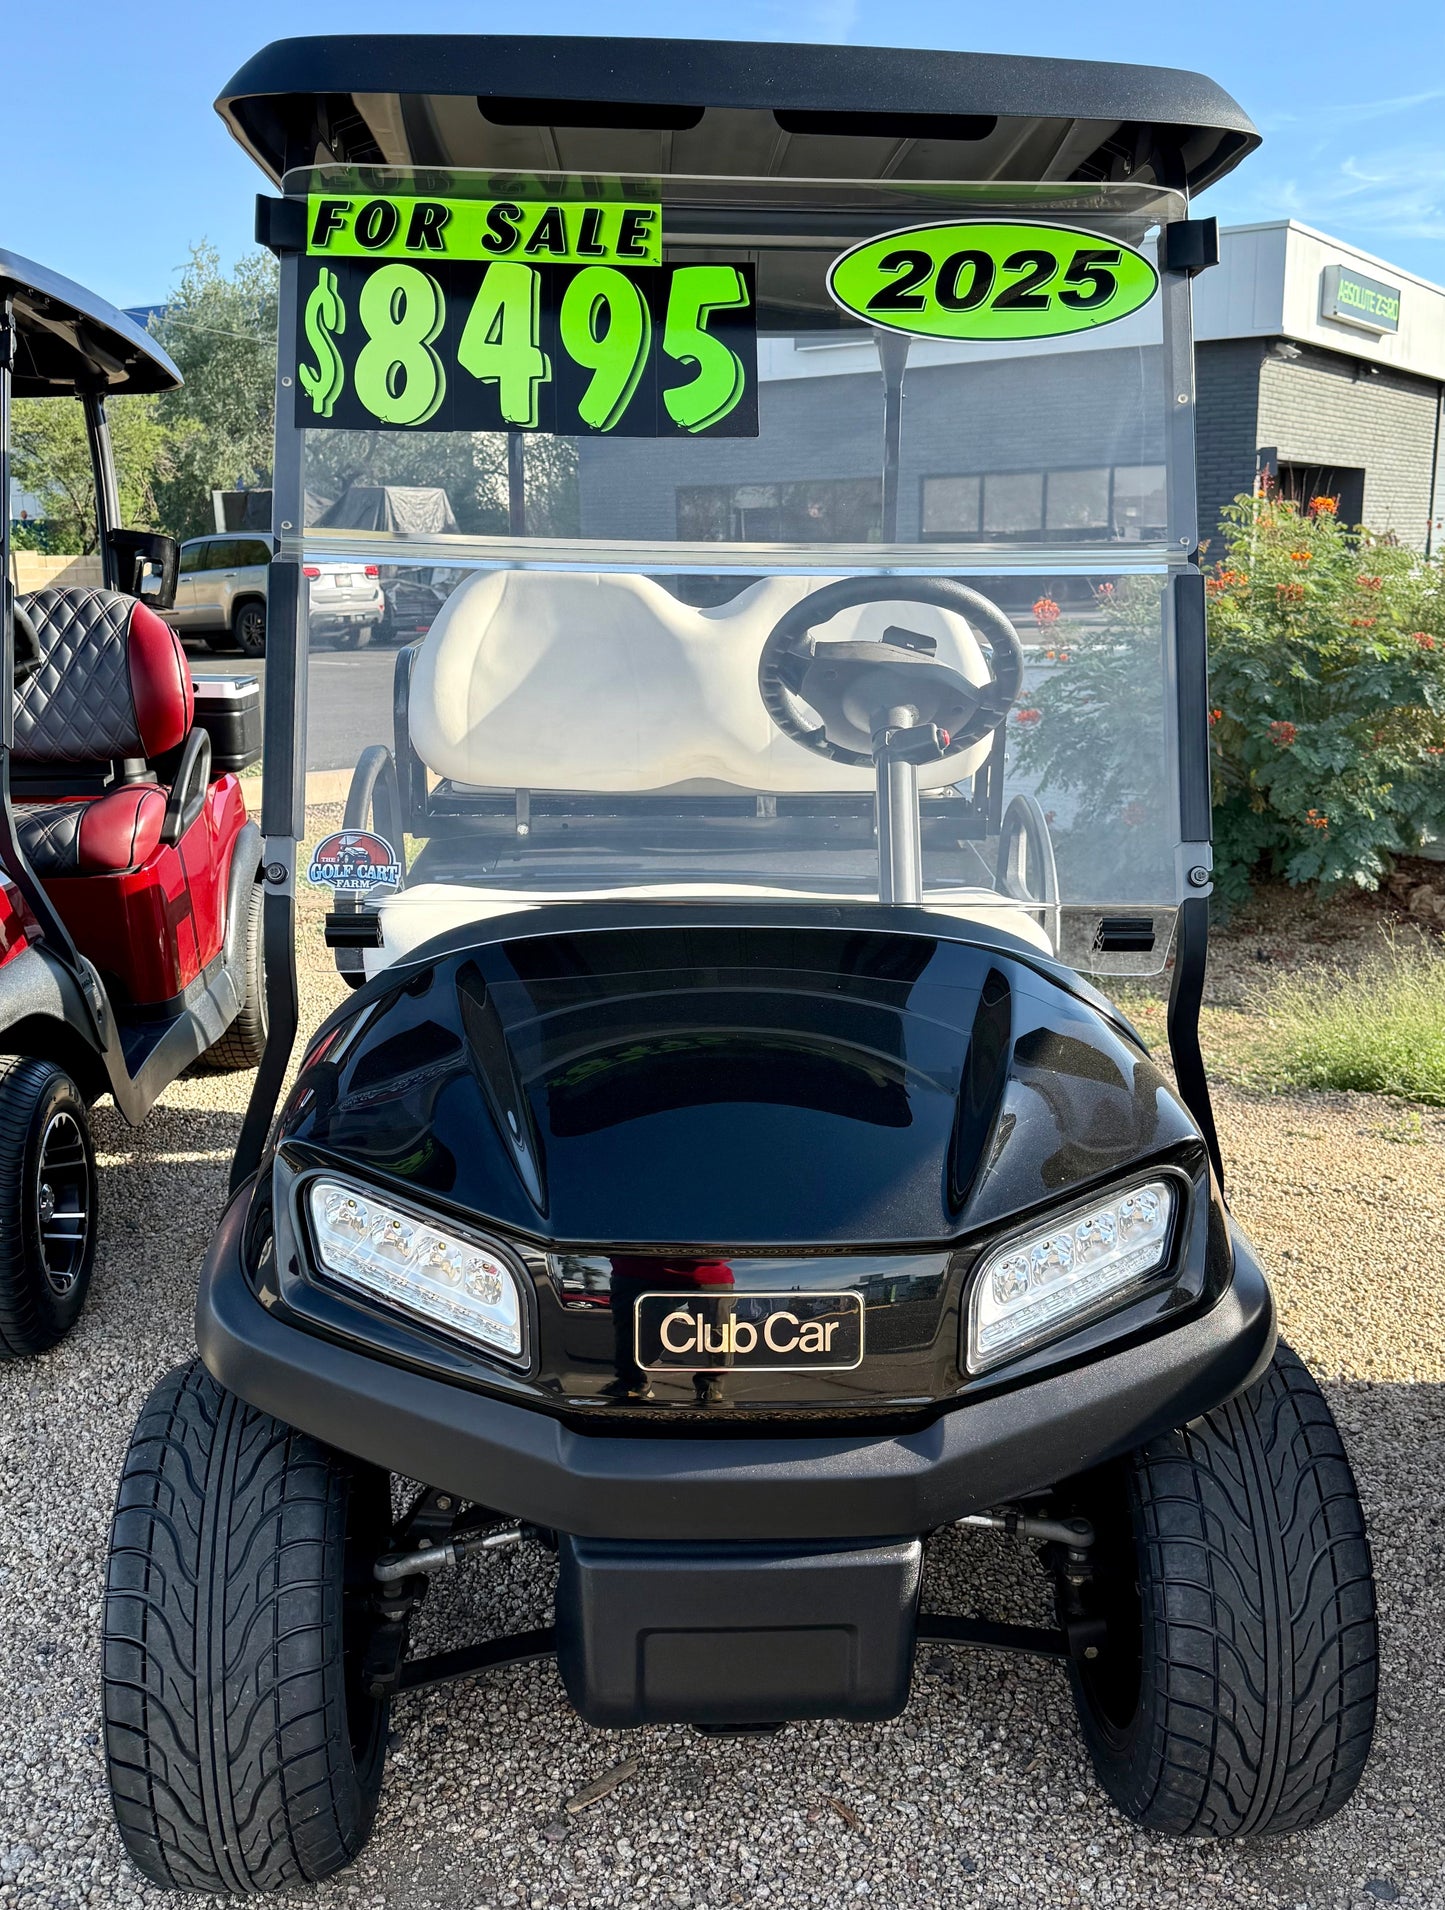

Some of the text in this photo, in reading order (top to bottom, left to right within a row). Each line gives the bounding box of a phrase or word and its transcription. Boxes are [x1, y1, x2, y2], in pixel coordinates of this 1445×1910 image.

[311, 198, 655, 257] FOR SALE
[866, 249, 1123, 312] 2025
[1337, 279, 1375, 313] ABSOLUTE
[298, 261, 751, 436] $8495
[310, 863, 397, 883] GOLF CART
[336, 879, 370, 888] FARM
[659, 1311, 839, 1353] Club Car
